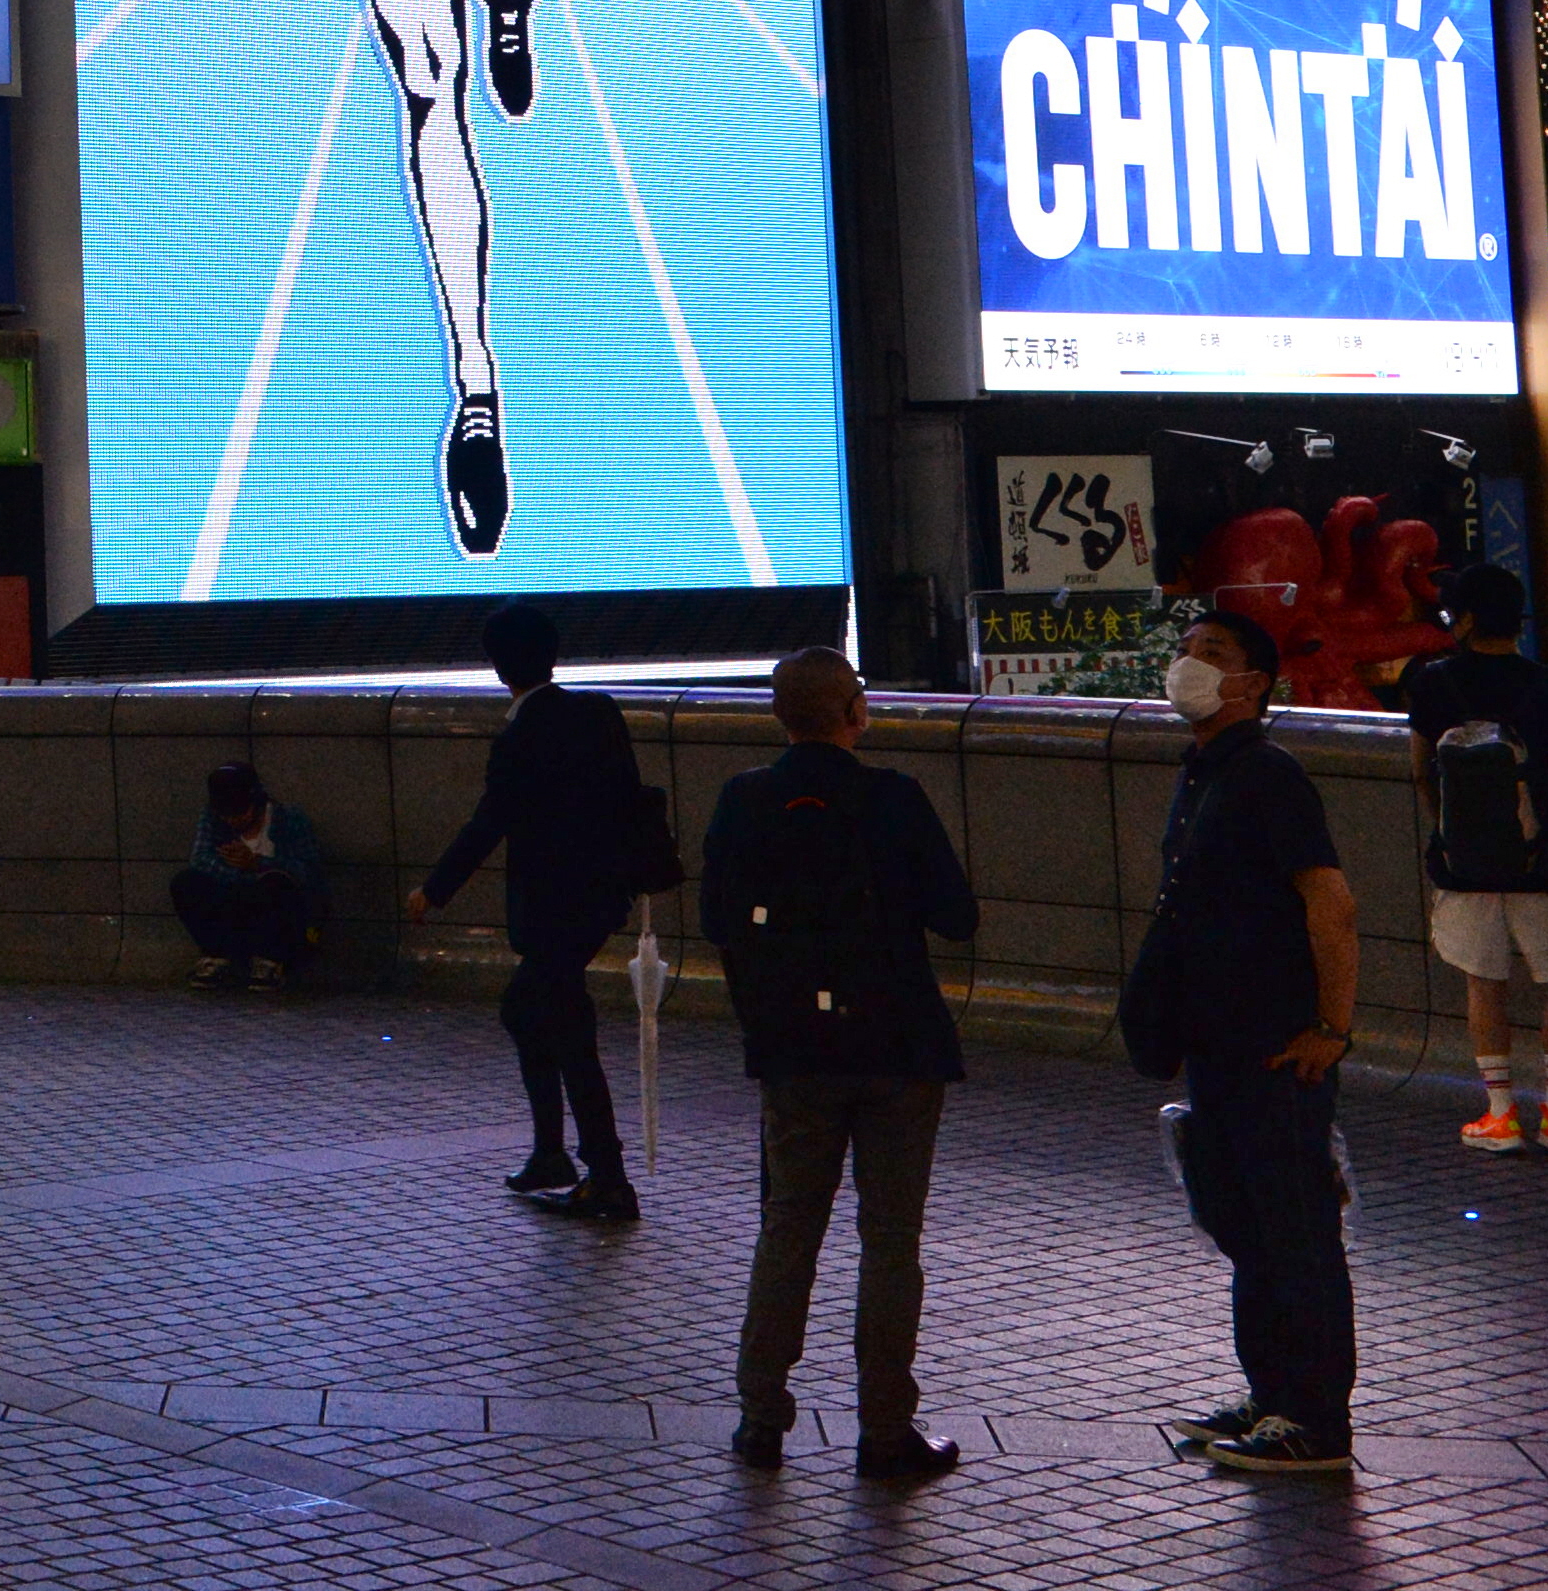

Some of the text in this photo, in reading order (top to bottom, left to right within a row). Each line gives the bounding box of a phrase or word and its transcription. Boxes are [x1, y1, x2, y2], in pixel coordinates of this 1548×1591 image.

[1002, 336, 1080, 369] 天気予報
[1462, 476, 1479, 552] 2F
